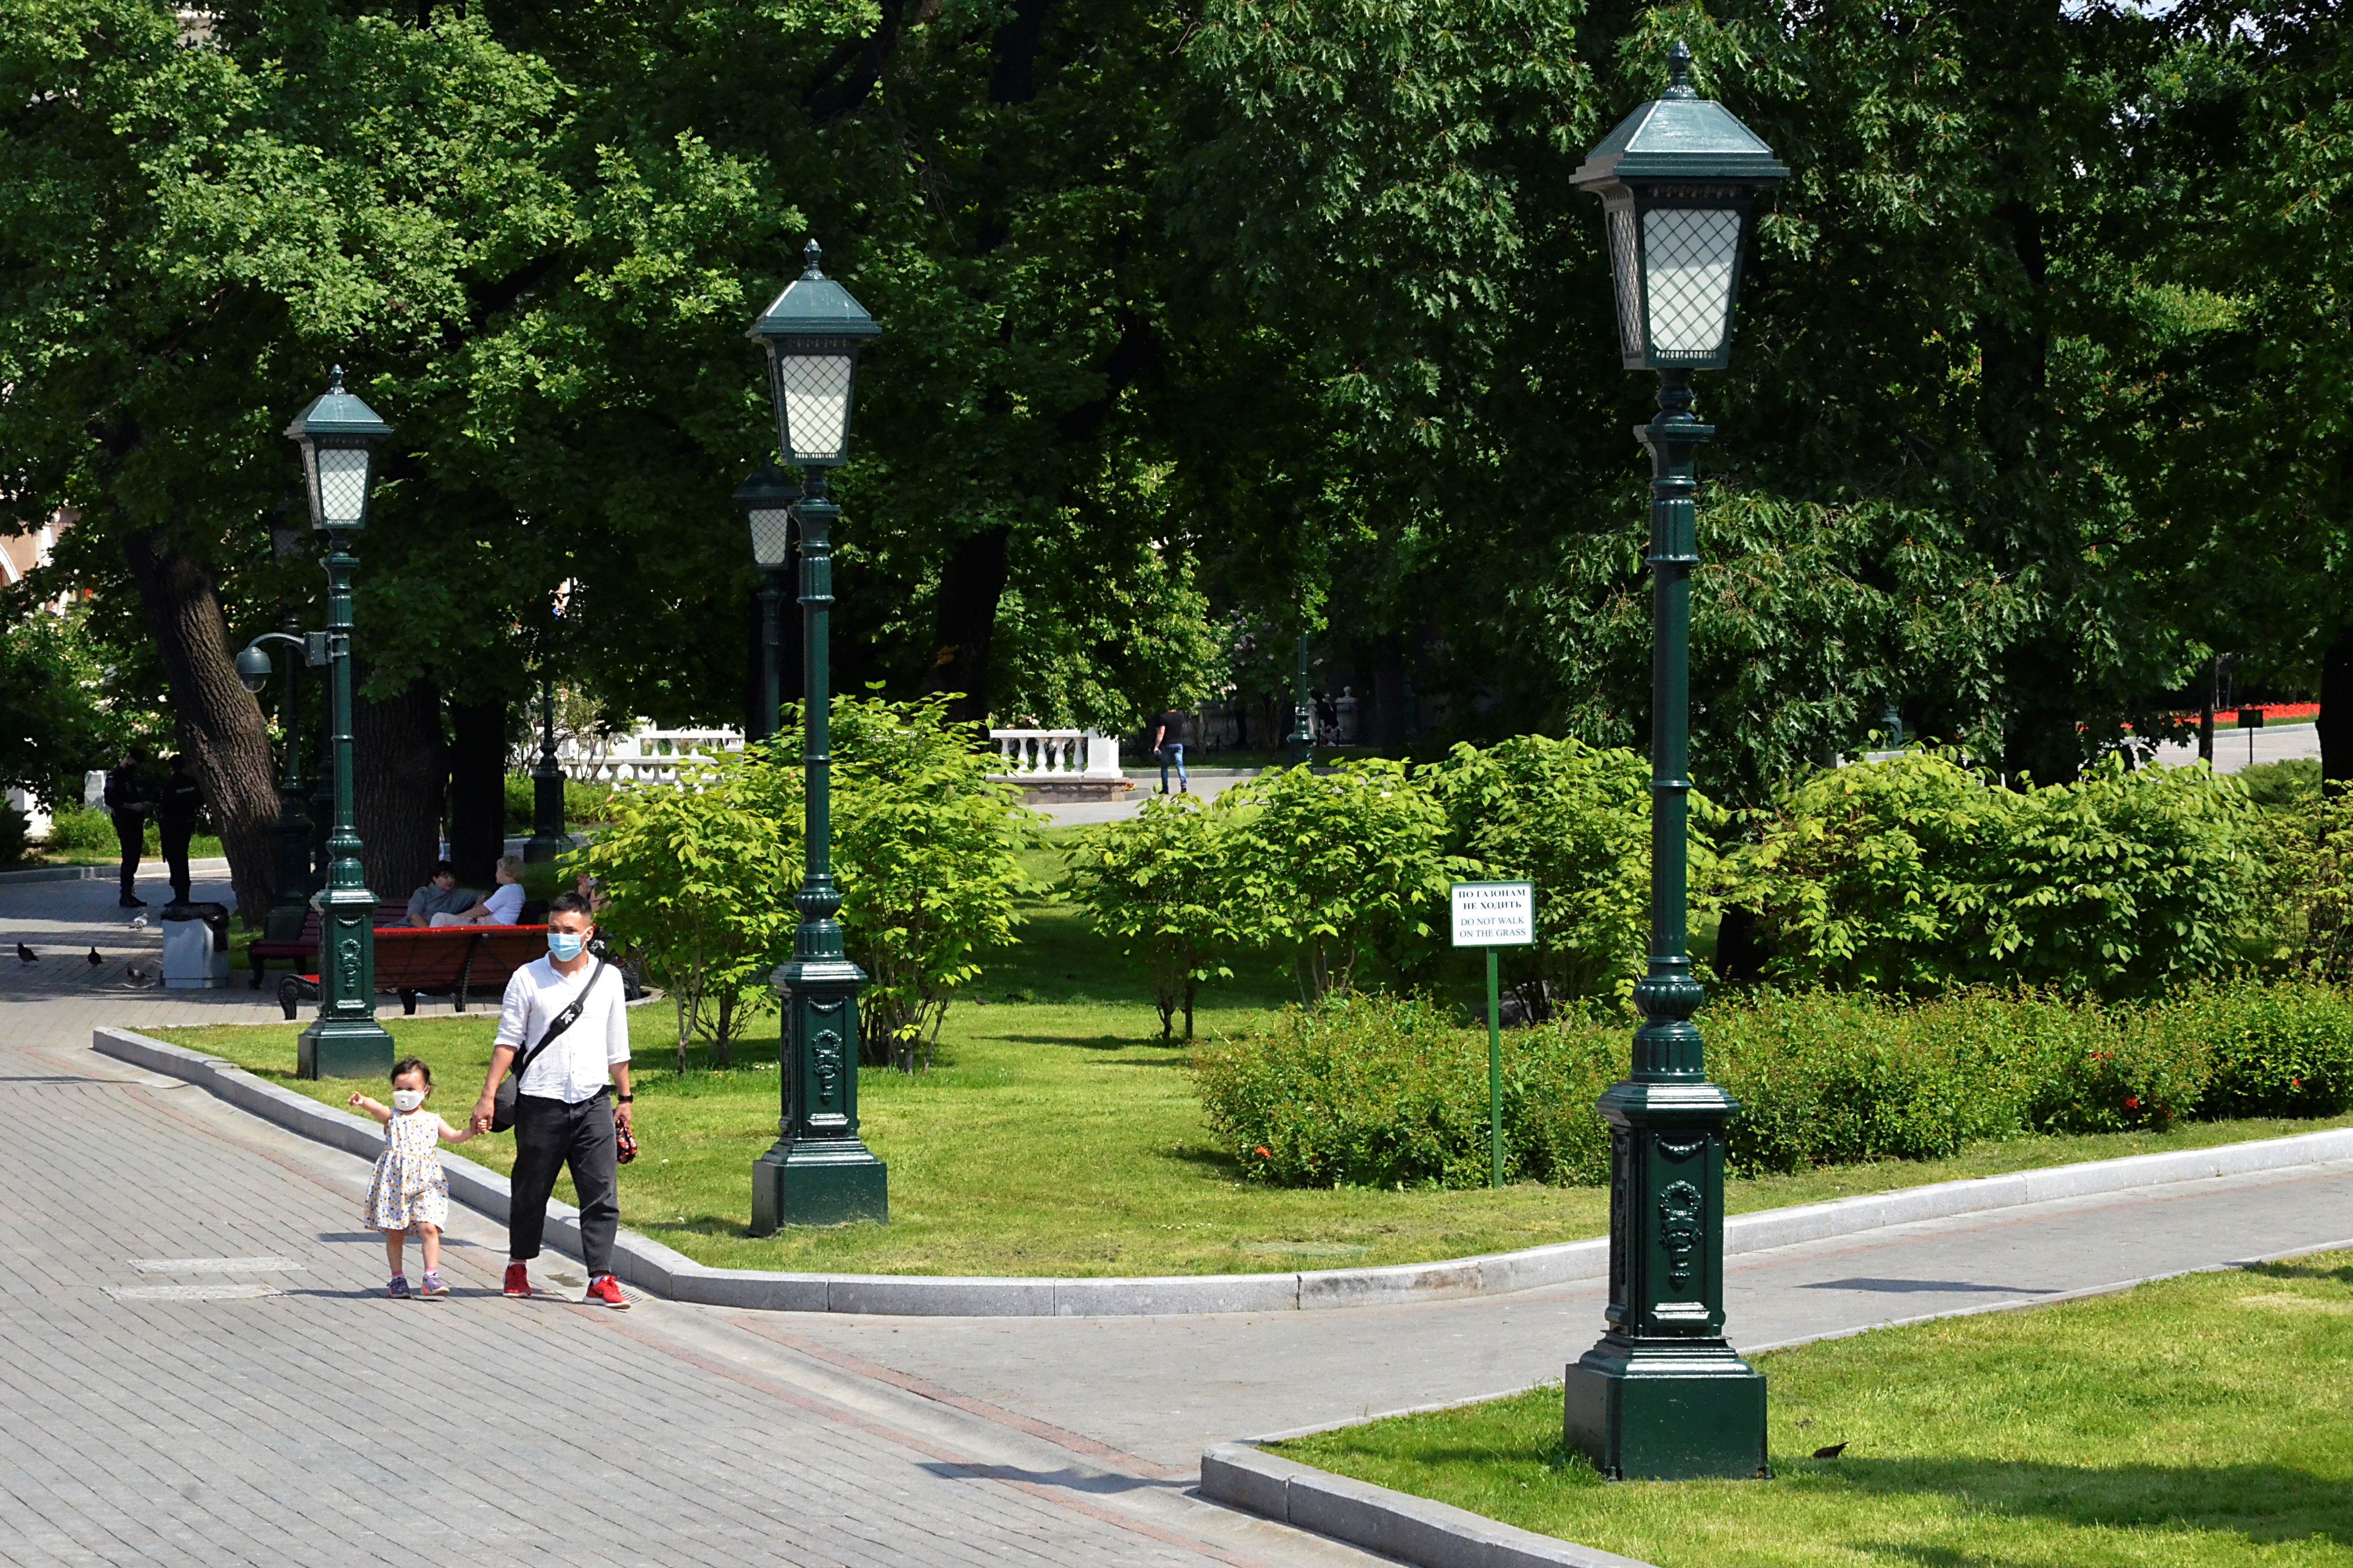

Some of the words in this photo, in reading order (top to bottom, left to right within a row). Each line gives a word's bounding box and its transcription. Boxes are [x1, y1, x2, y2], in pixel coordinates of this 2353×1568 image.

[1477, 889, 1525, 897] ГАЗОНАМ
[1480, 901, 1521, 910] ХОДИТЬ
[1477, 917, 1495, 925] NOT
[1460, 930, 1473, 938] ON
[1476, 929, 1493, 937] THE
[1496, 929, 1526, 937] GRASS
